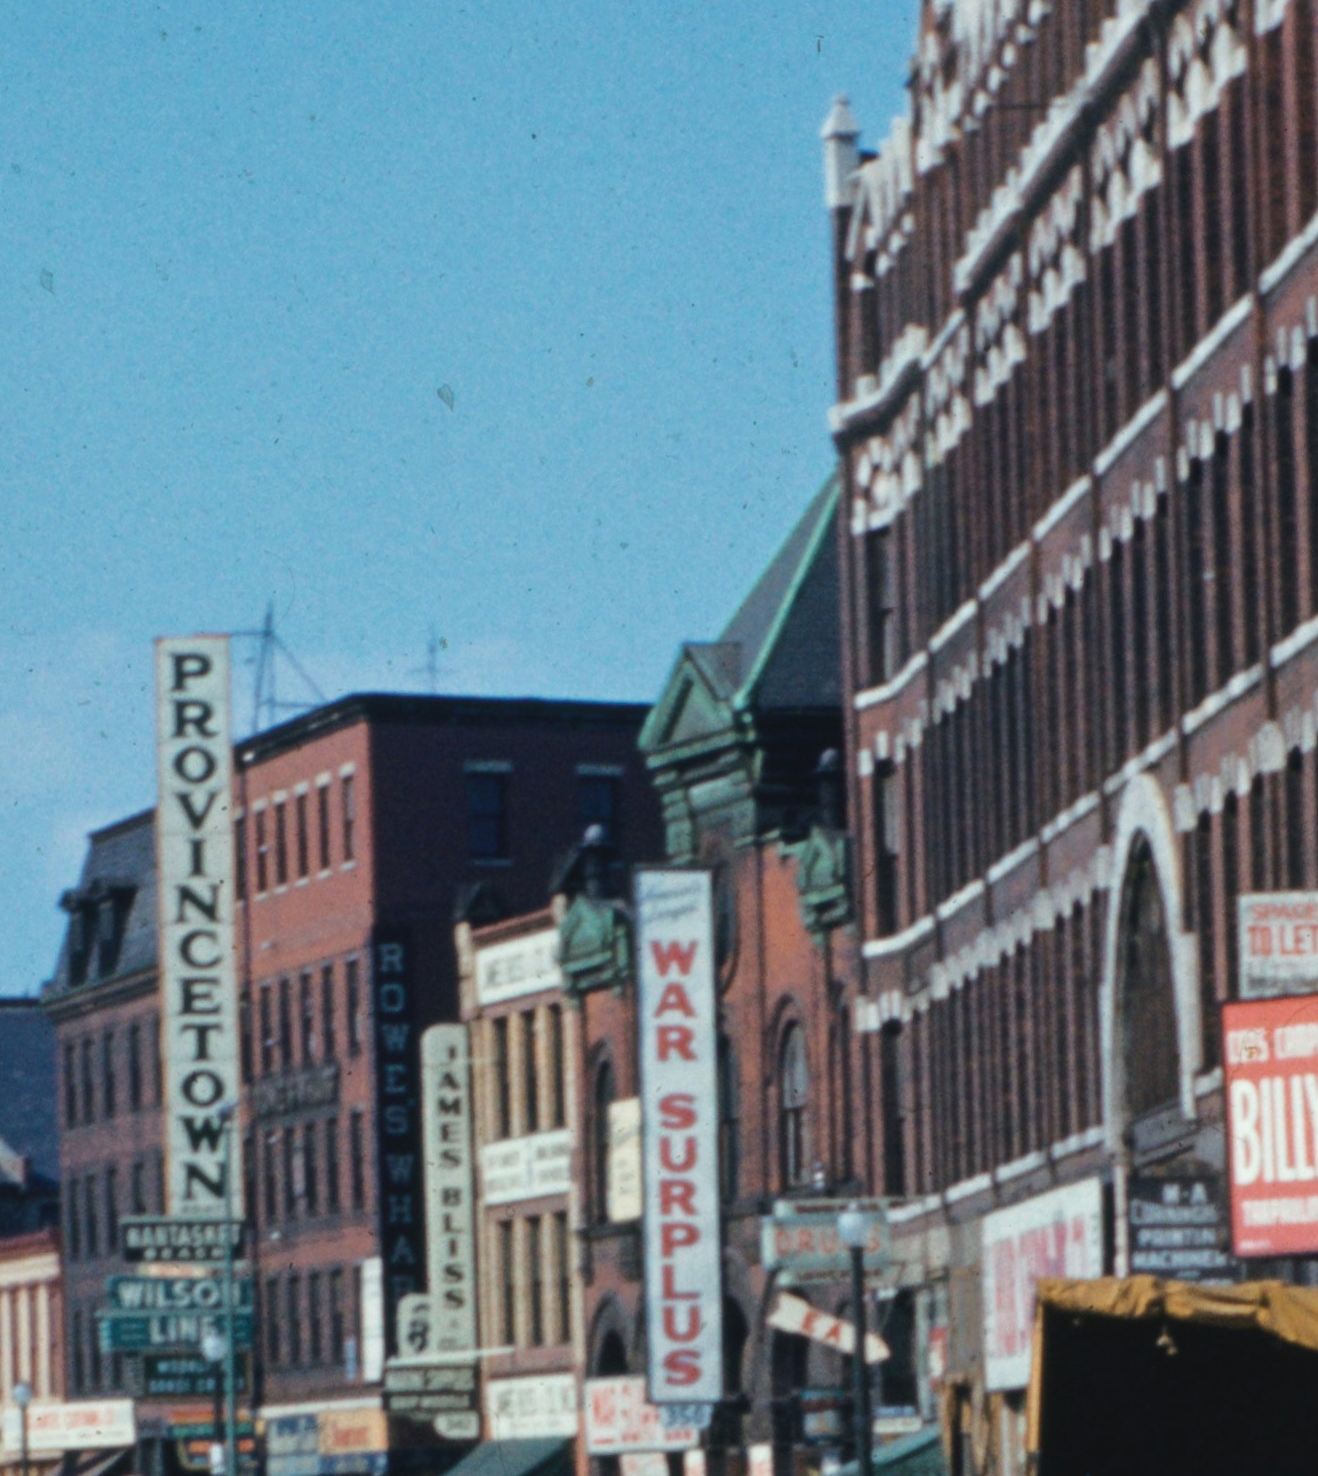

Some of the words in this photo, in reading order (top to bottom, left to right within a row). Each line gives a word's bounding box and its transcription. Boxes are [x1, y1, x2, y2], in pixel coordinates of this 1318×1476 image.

[169, 652, 227, 1202] PROVINCETOWN
[1248, 926, 1272, 957] TO
[649, 940, 698, 1062] WAR
[440, 1187, 465, 1311] BLISS
[657, 1092, 703, 1387] SURPLUS
[775, 1227, 882, 1256] DRUS
